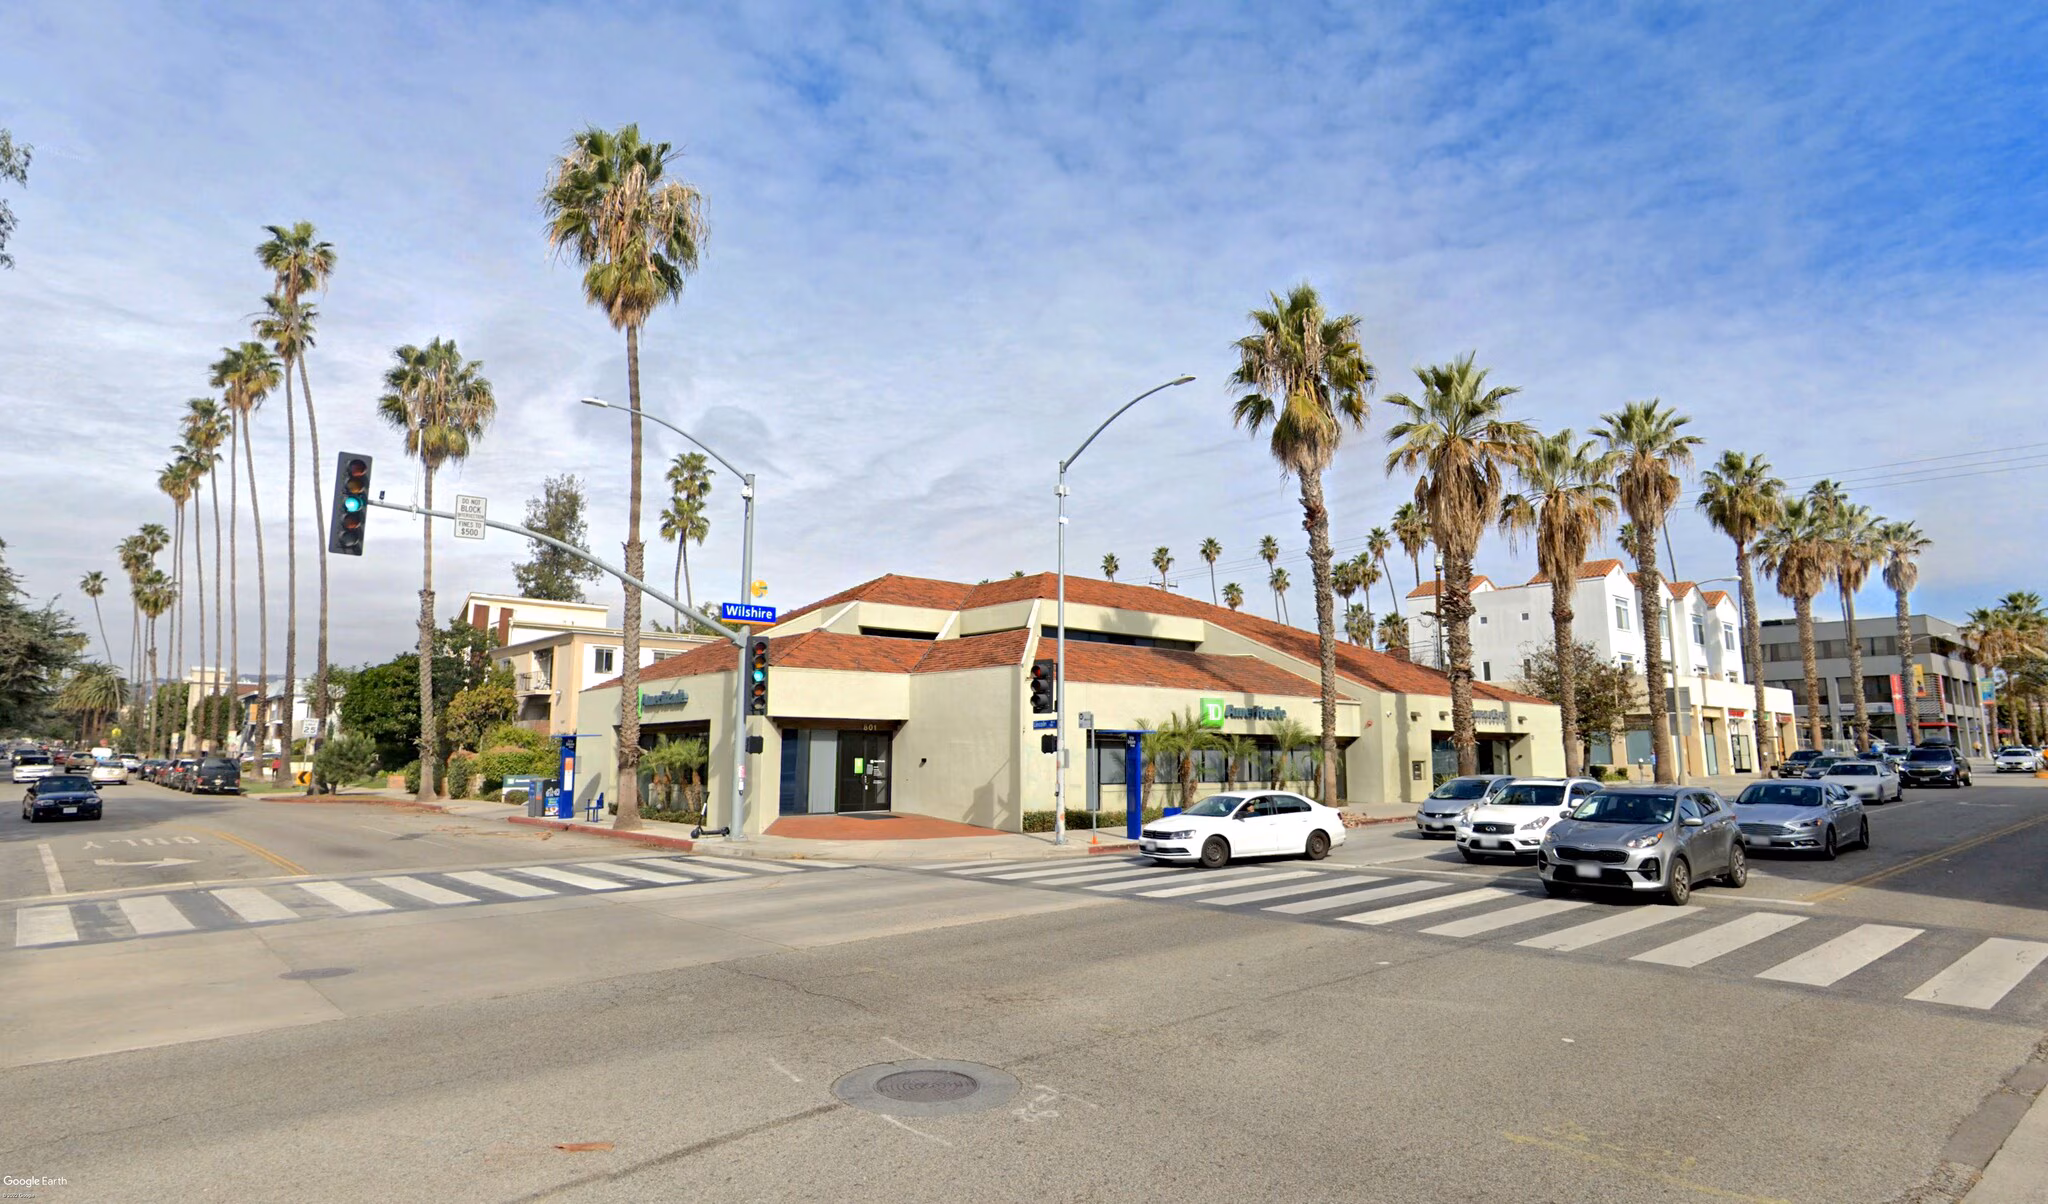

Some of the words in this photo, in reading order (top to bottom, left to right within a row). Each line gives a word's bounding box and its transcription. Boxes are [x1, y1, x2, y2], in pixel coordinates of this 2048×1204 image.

[460, 505, 482, 513] BLOCK
[461, 528, 479, 537] $500
[726, 605, 773, 619] Wilshire
[1206, 703, 1222, 720] TD
[1225, 704, 1287, 721] Ameritrade
